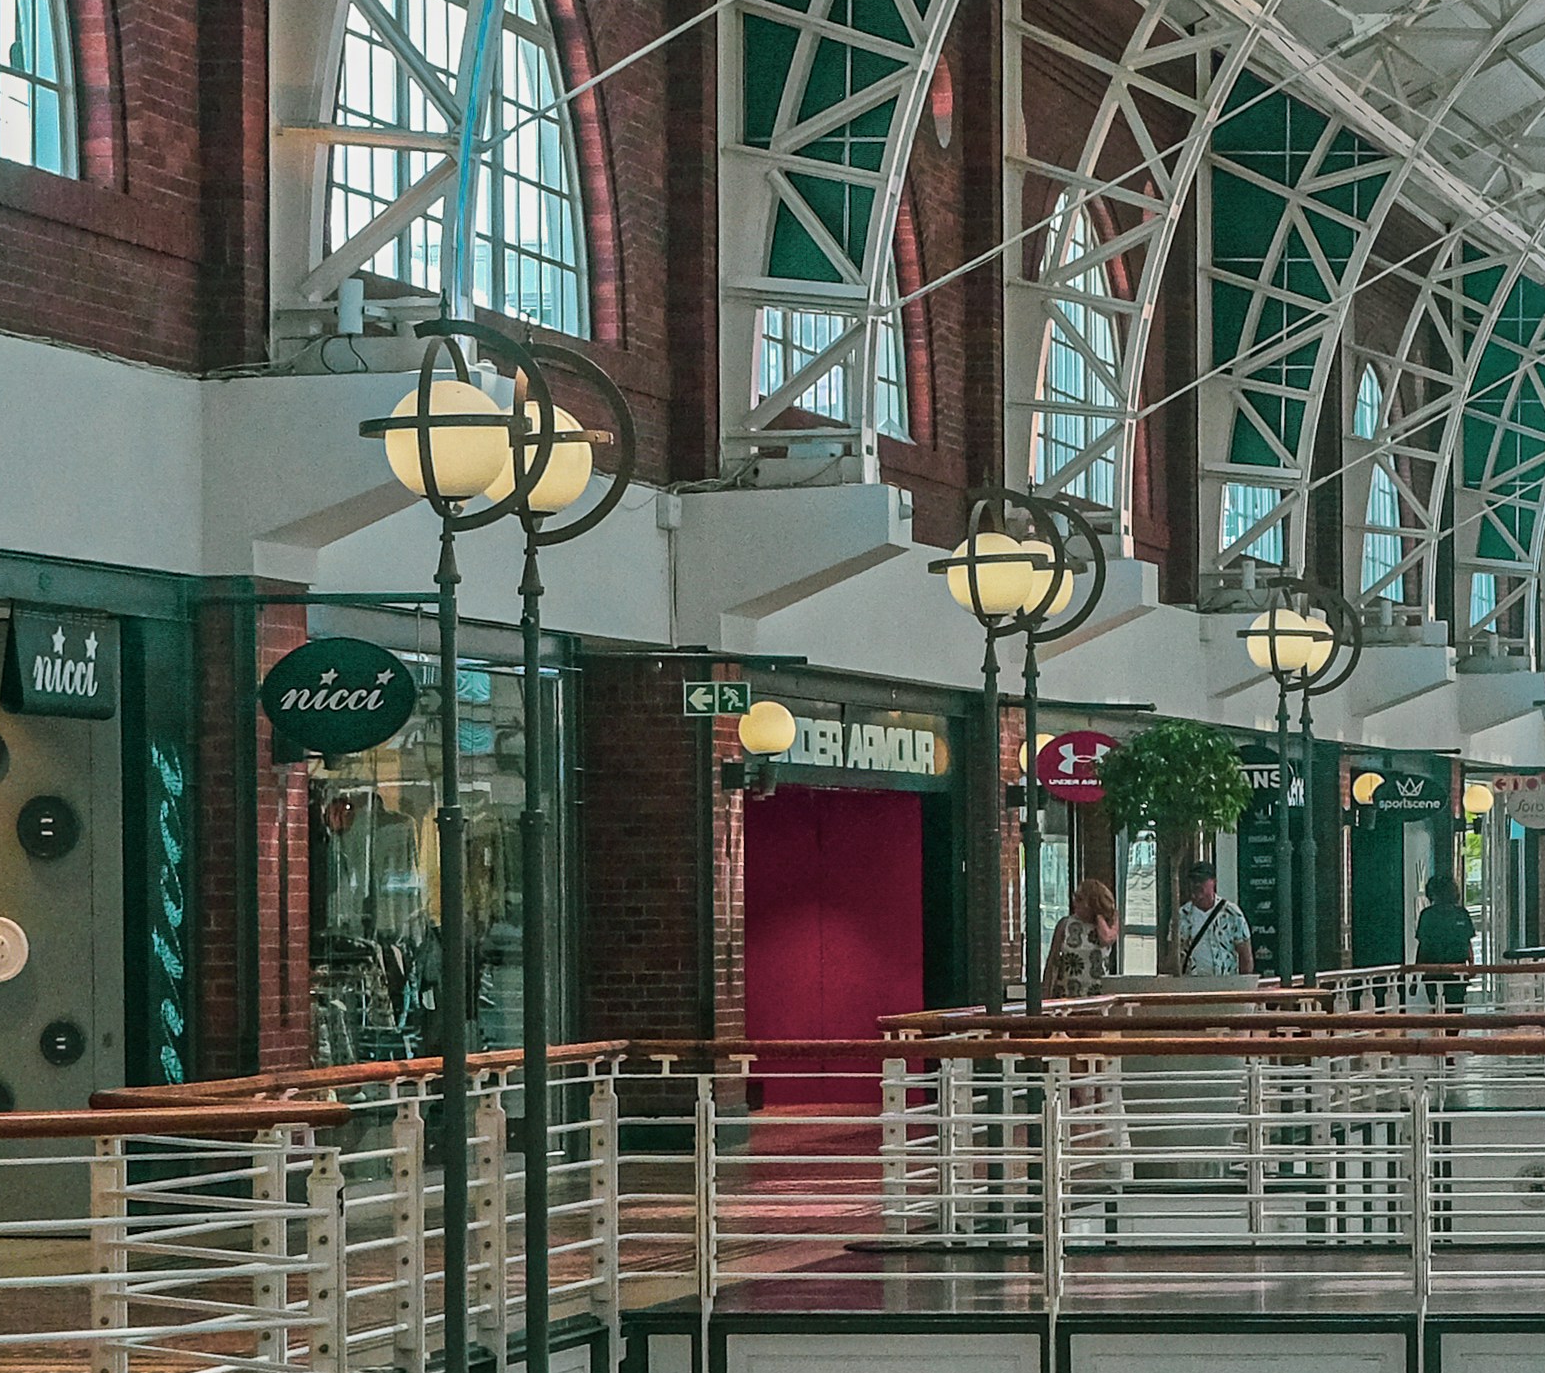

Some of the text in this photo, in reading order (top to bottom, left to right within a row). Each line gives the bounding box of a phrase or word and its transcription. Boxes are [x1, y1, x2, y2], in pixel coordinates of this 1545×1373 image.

[33, 625, 99, 697] nicci
[280, 668, 395, 711] nicci
[846, 723, 936, 775] ARMOUR
[1379, 799, 1441, 810] sportscene
